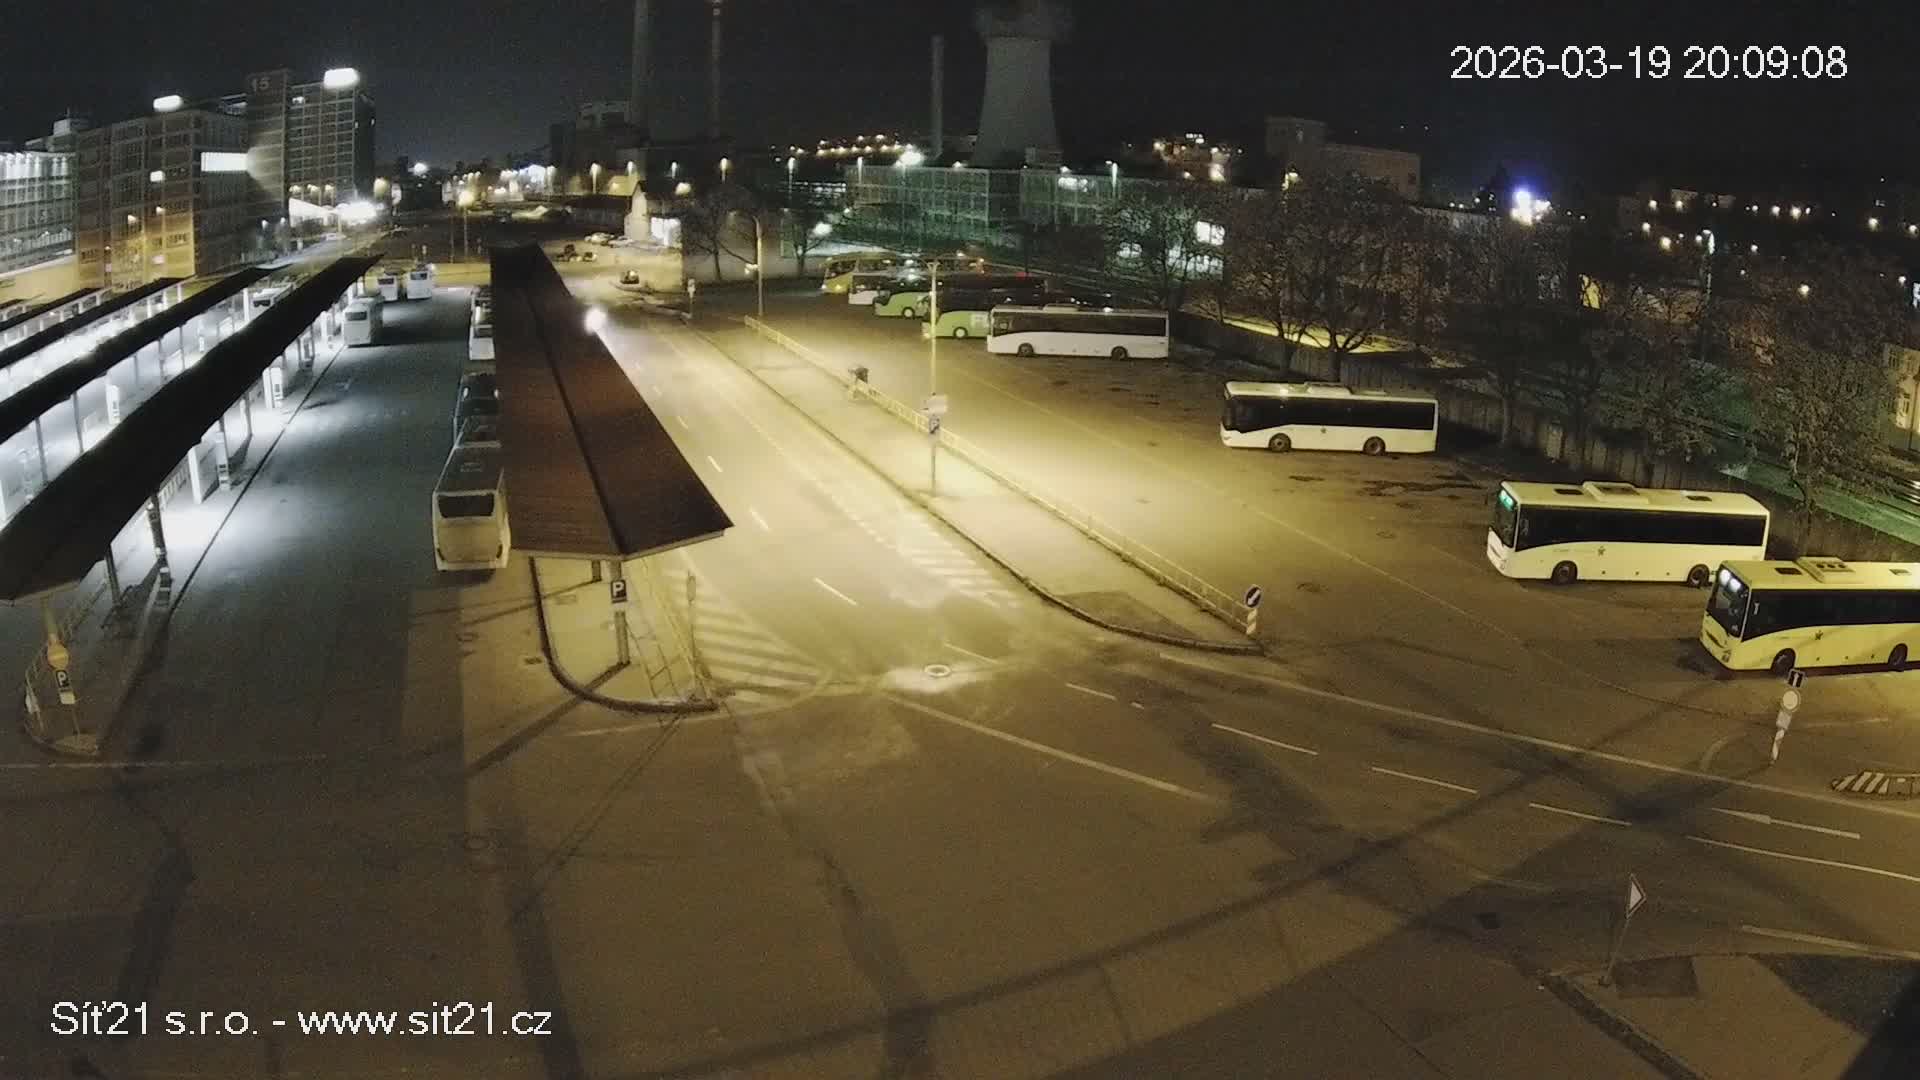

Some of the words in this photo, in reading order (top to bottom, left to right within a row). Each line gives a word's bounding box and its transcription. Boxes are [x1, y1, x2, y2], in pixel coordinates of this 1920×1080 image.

[251, 77, 271, 92] 15
[612, 581, 625, 597] P
[57, 671, 67, 687] P
